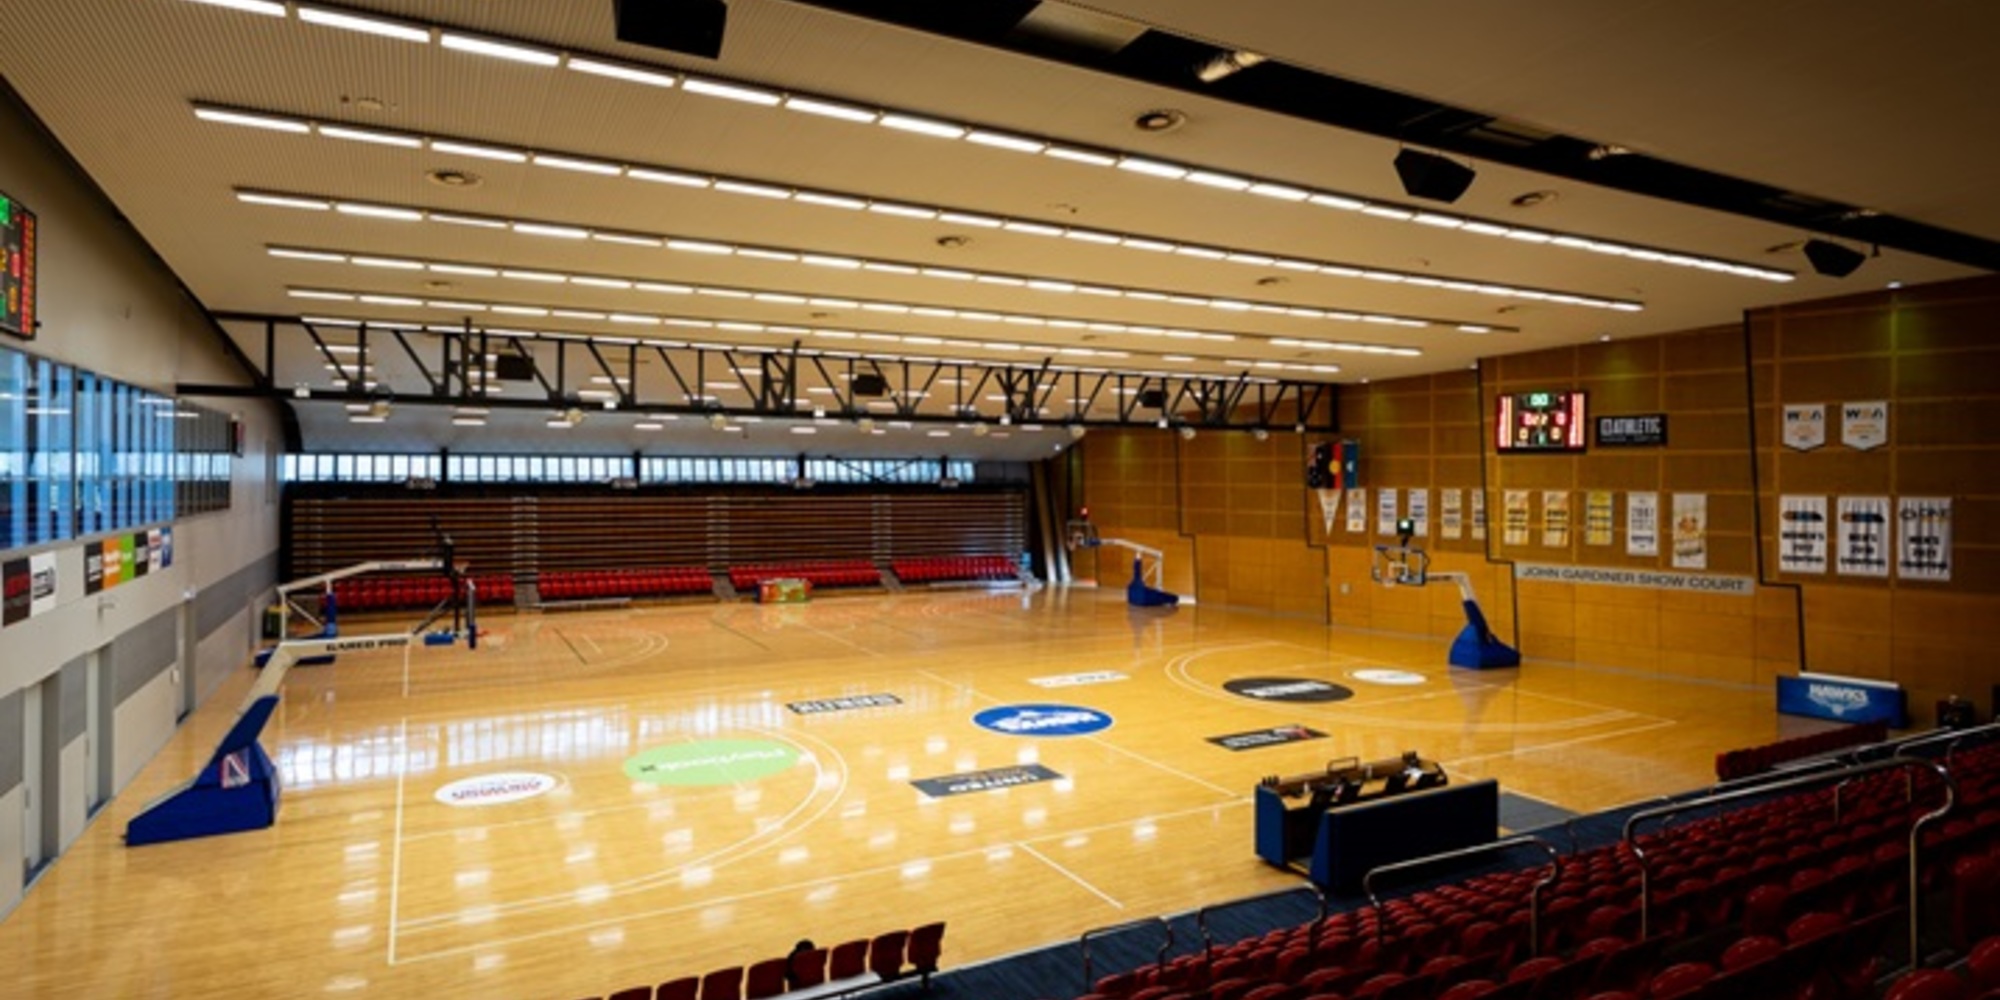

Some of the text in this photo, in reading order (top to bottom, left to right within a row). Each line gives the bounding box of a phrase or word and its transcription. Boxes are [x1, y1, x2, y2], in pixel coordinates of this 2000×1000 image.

[1613, 416, 1661, 434] ATHLETIC
[1524, 567, 1745, 591] JOHN GARDINER SHOW COURT
[1809, 683, 1868, 705] HAWKS
[948, 774, 1038, 792] UNITED
